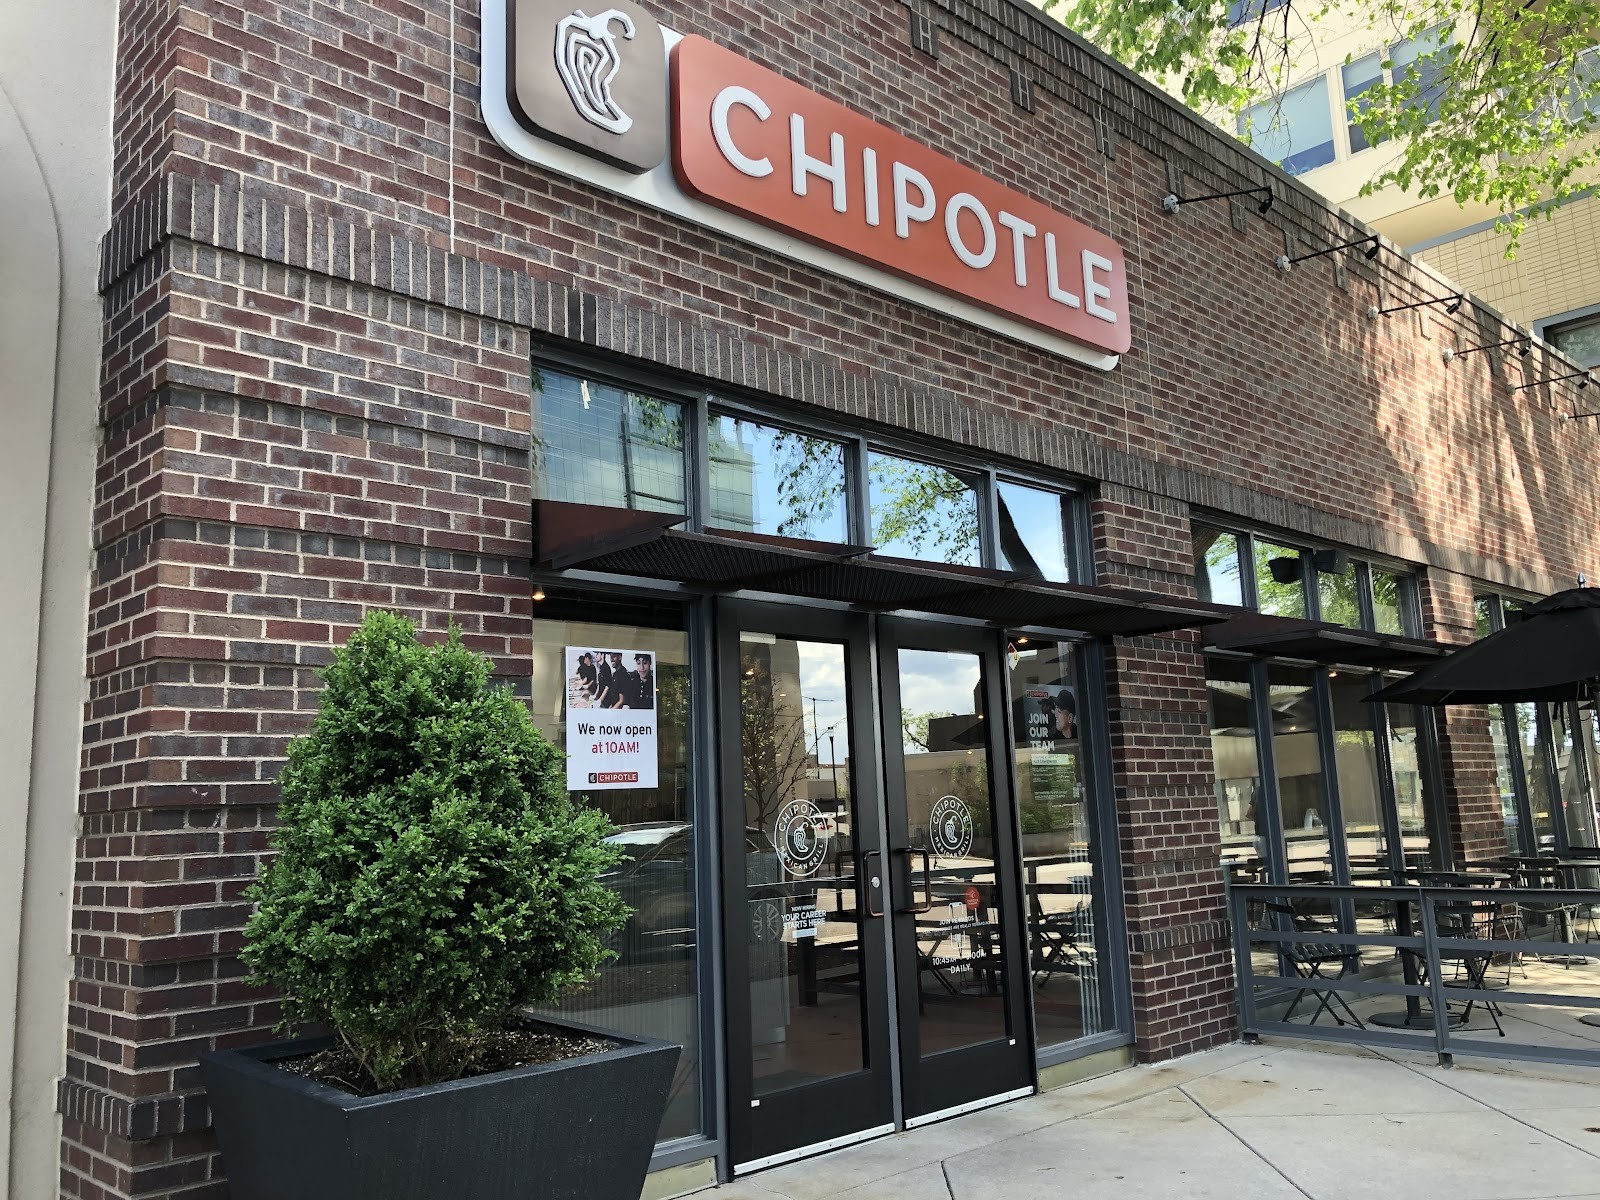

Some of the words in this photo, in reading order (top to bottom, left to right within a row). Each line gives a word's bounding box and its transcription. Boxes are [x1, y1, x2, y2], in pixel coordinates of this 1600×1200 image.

[711, 86, 1117, 323] CHIPOTLE
[1028, 713, 1049, 724] JOIN
[578, 723, 595, 735] We
[599, 725, 622, 735] now
[625, 726, 652, 738] open
[1029, 726, 1049, 738] OUR
[592, 742, 603, 753] at
[605, 741, 640, 753] 10AM!
[1030, 740, 1055, 752] TEAM
[599, 773, 637, 782] CHIPOTLE
[932, 799, 970, 825] CHIPOTLE
[934, 836, 958, 858] MEXICAN
[957, 835, 970, 856] GRILL
[809, 843, 824, 867] GRILL
[780, 912, 800, 922] YOUR
[800, 910, 826, 919] CAREER
[783, 919, 807, 929] STARTS
[808, 917, 826, 927] HERE
[950, 963, 971, 974] DAILY
